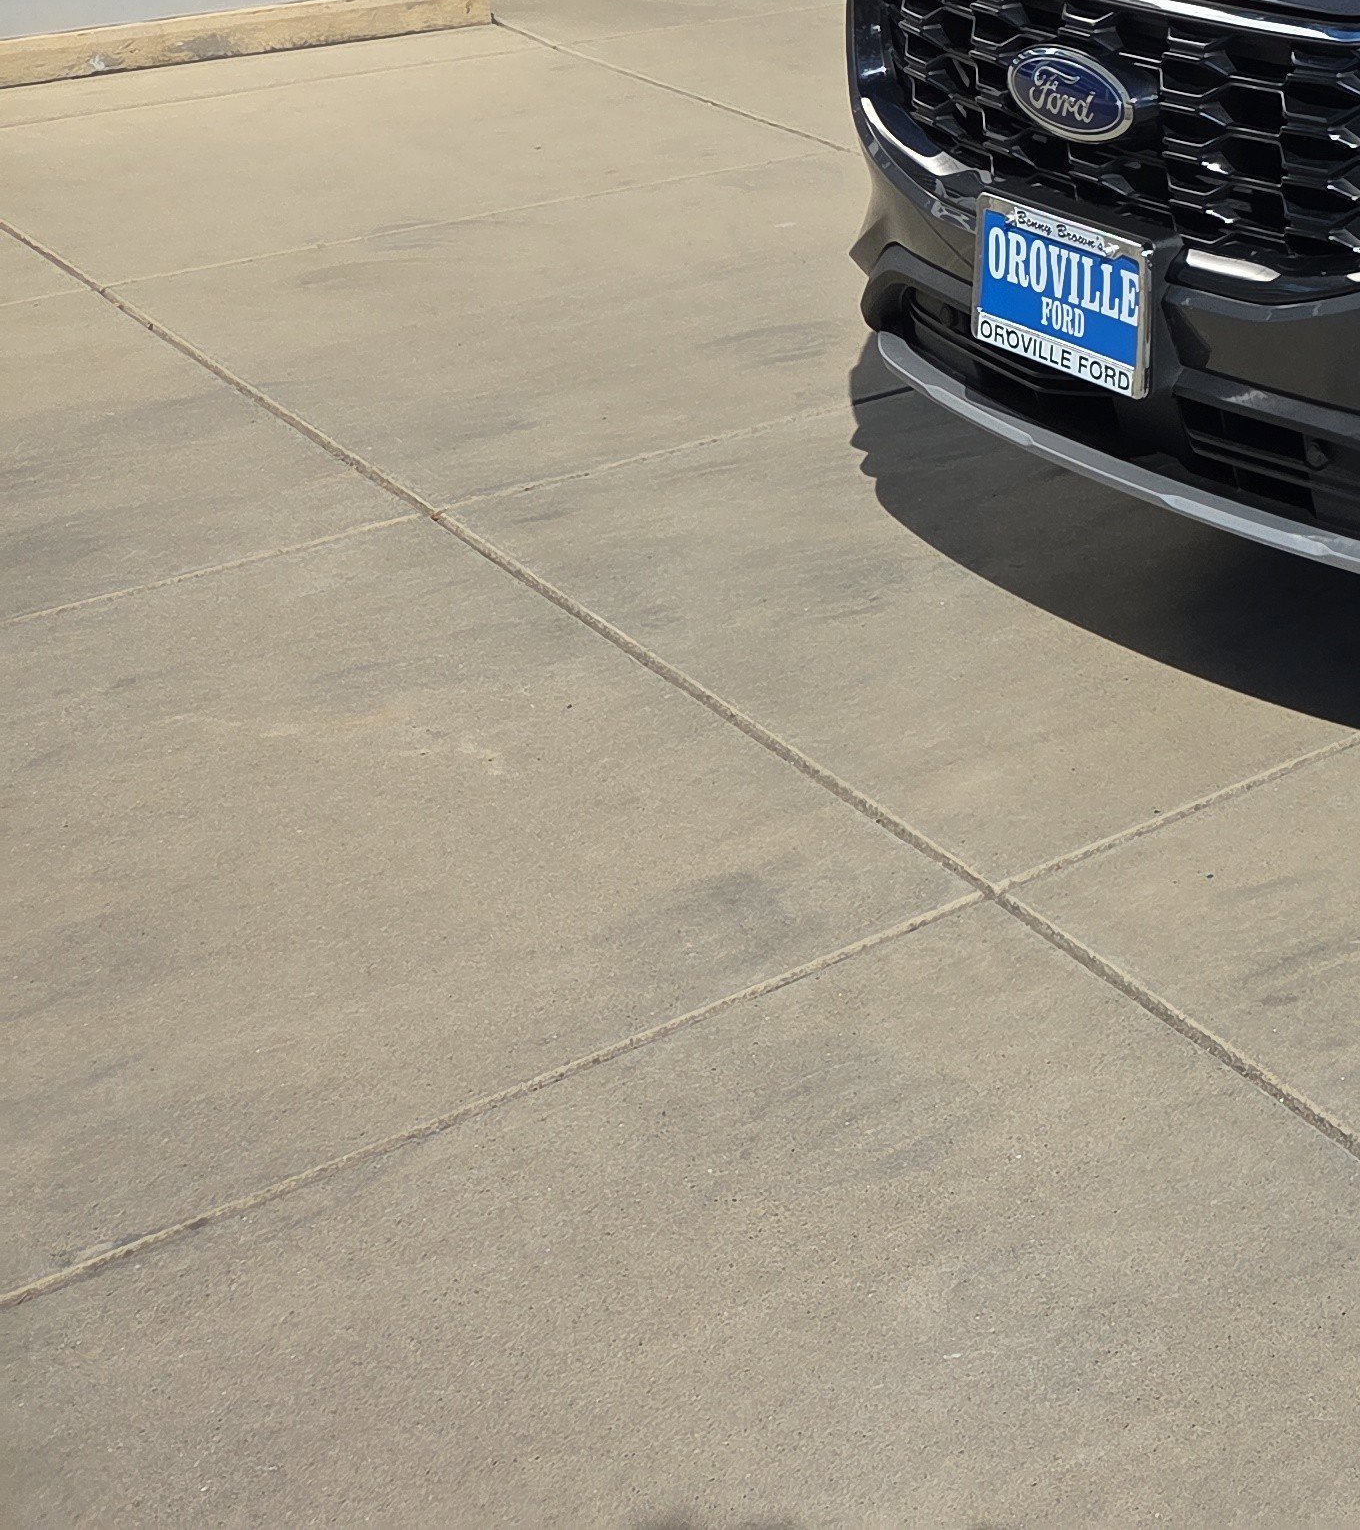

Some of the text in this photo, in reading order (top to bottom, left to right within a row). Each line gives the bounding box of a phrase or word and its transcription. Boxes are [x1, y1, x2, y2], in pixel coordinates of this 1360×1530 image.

[1028, 64, 1095, 124] Ford
[1016, 210, 1104, 252] Benny Brown's
[988, 226, 1140, 327] OROVILLE
[1040, 296, 1085, 338] FORD
[980, 319, 1130, 391] OROVILLE FORD
